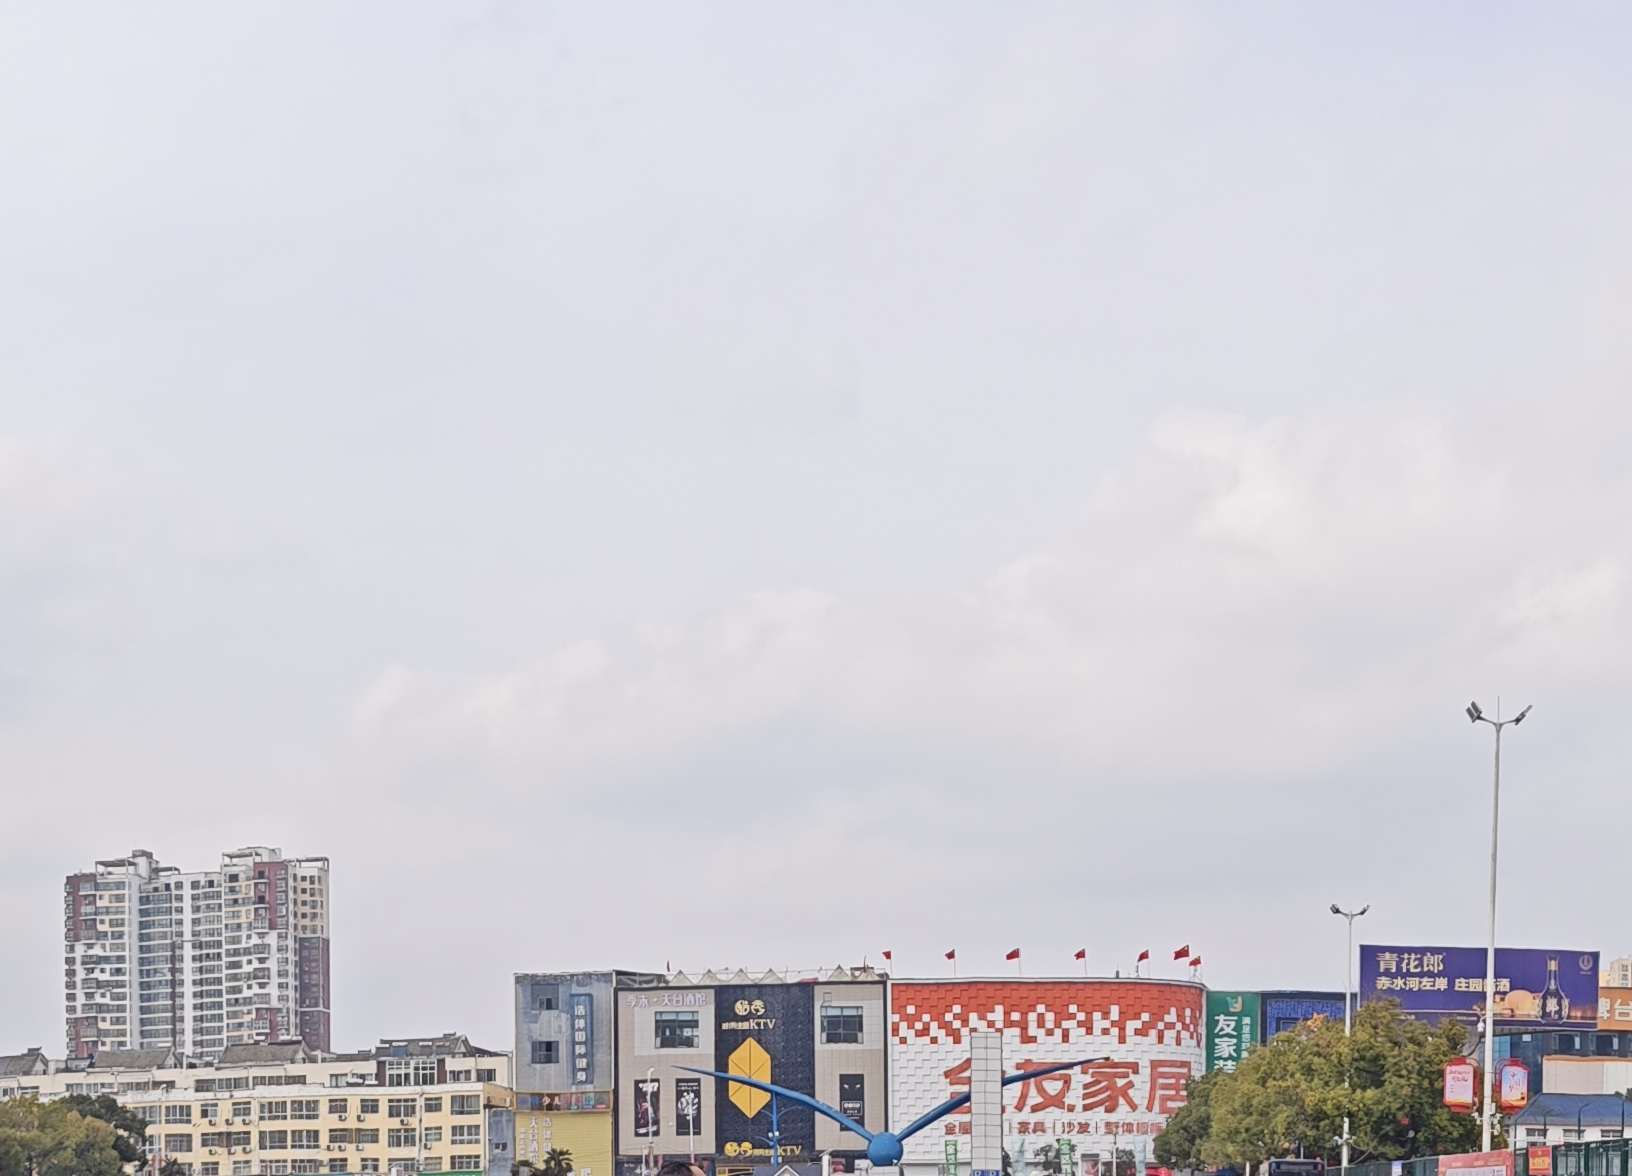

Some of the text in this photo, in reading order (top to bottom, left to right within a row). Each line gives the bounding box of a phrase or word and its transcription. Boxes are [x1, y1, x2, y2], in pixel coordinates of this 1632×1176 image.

[1376, 952, 1444, 973] 青花郎
[1376, 976, 1448, 991] 赤水河左岸
[1017, 1121, 1047, 1135] 家具
[1061, 1121, 1091, 1135] 沙发
